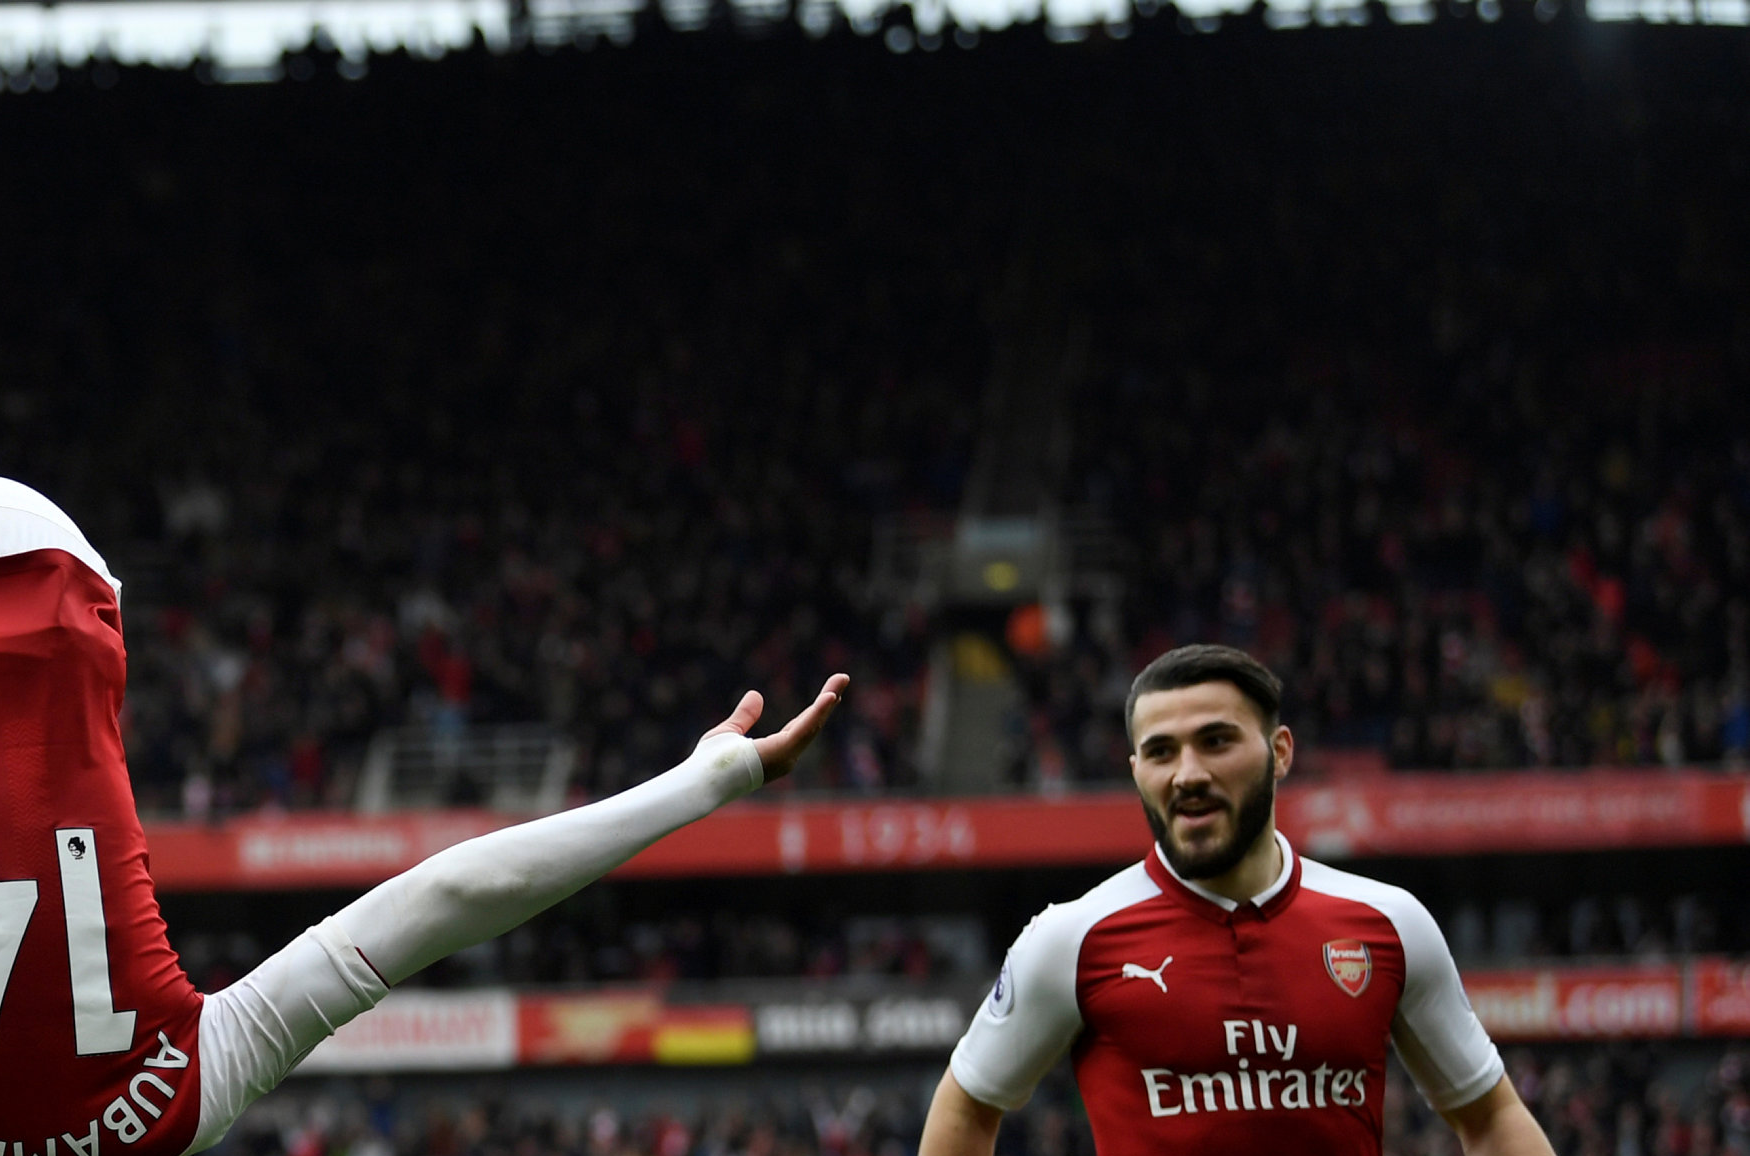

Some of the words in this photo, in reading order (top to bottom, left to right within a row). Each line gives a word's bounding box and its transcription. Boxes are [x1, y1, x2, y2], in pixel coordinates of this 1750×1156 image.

[1330, 947, 1364, 959] Arsenal
[1223, 1020, 1297, 1060] Fly
[1141, 1058, 1367, 1118] Emirates
